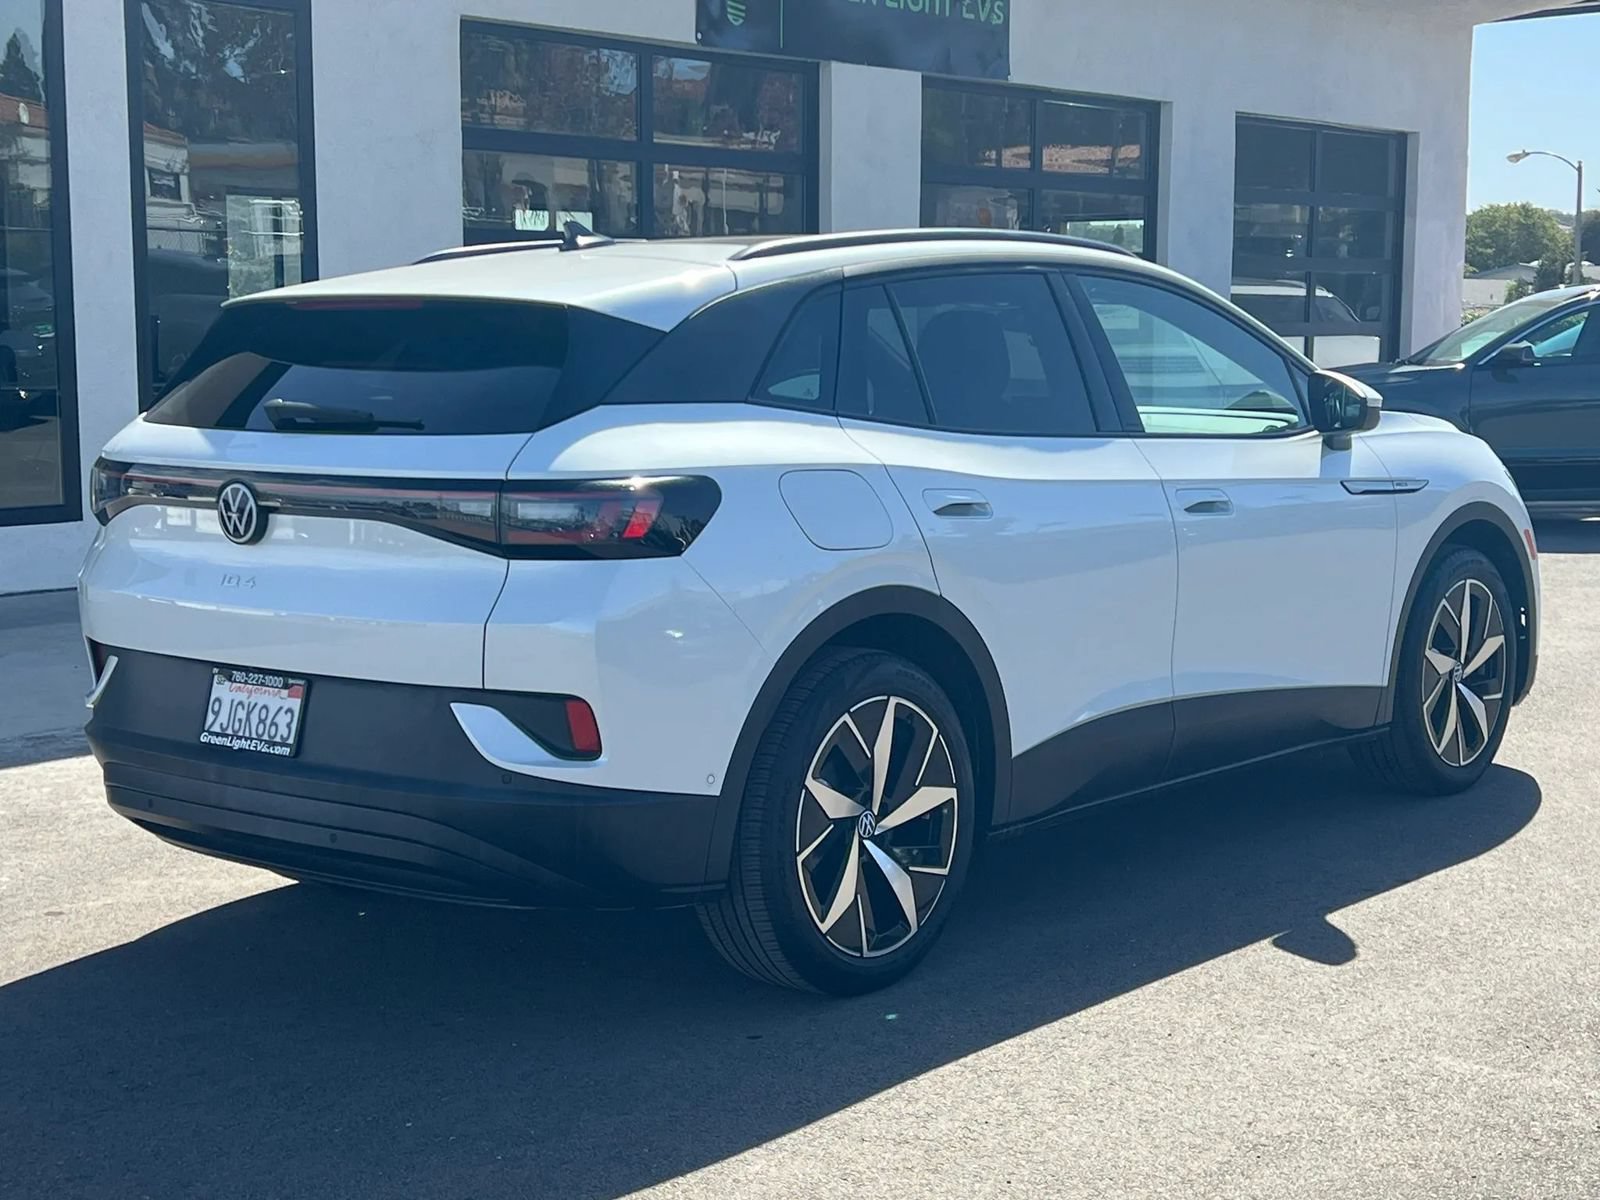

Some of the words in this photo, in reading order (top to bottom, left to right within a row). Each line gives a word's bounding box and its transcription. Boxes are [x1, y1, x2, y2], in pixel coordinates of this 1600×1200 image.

[231, 670, 283, 688] 760-227-1000
[229, 681, 284, 699] California
[208, 696, 295, 742] 9JGK863
[199, 731, 291, 756] GreenLightEVs.com
